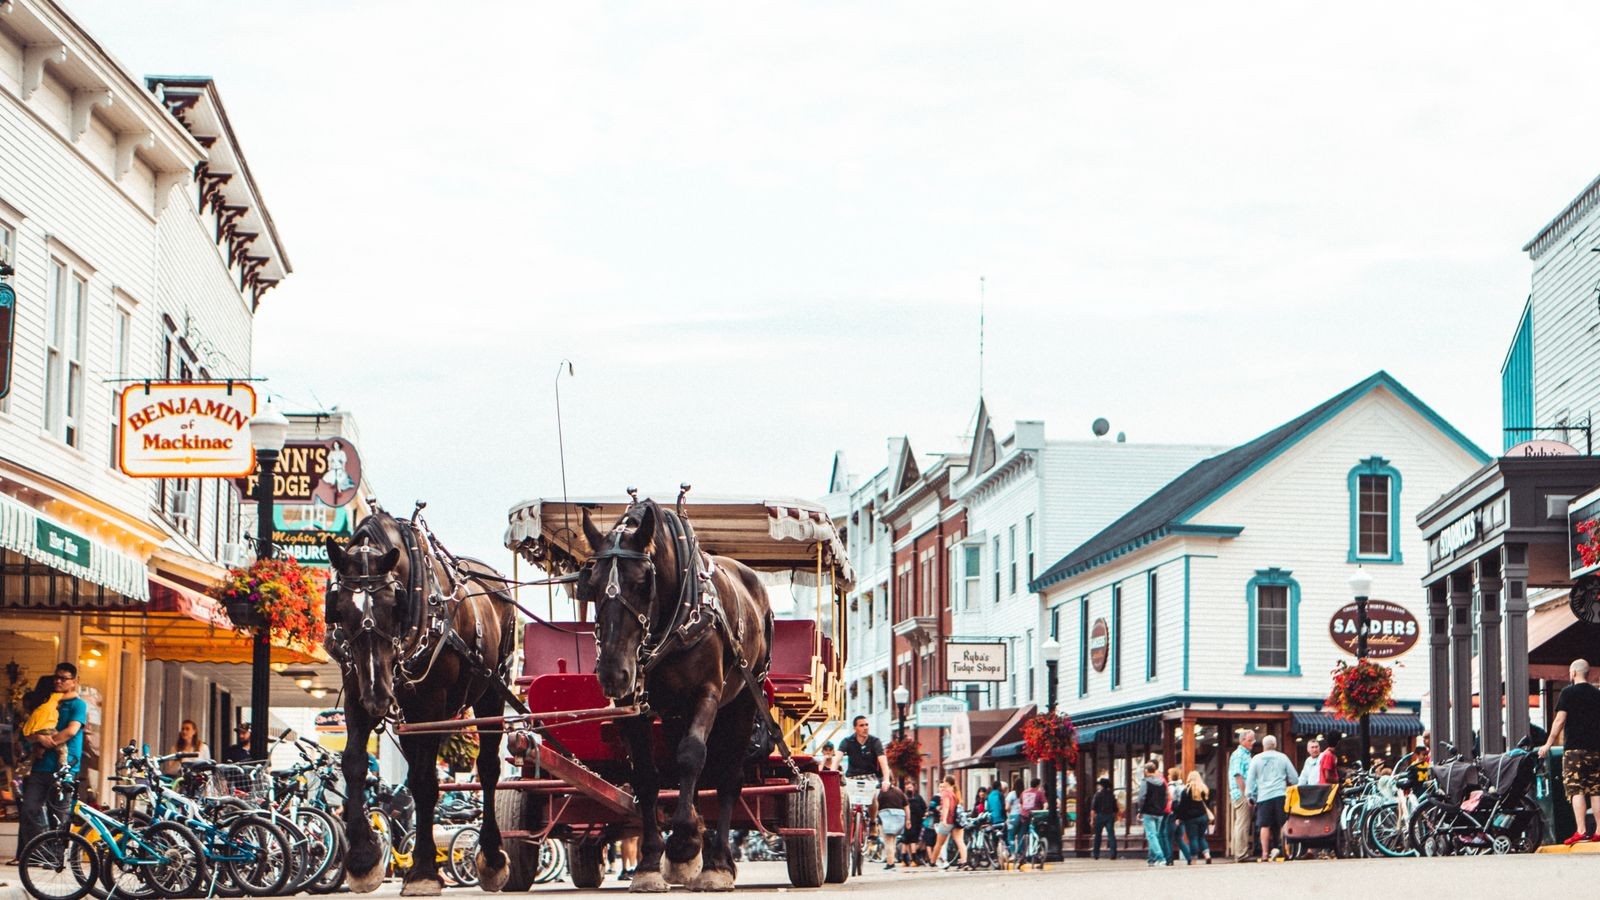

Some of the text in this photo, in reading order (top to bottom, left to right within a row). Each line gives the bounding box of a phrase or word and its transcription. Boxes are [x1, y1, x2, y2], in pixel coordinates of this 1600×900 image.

[128, 397, 248, 431] BENJAMIN
[181, 419, 195, 429] of
[143, 433, 233, 449] Mackinac
[247, 475, 310, 496] FDGE
[272, 531, 316, 544] Mighty
[963, 650, 990, 663] Ryba's
[977, 663, 1001, 674] Shops
